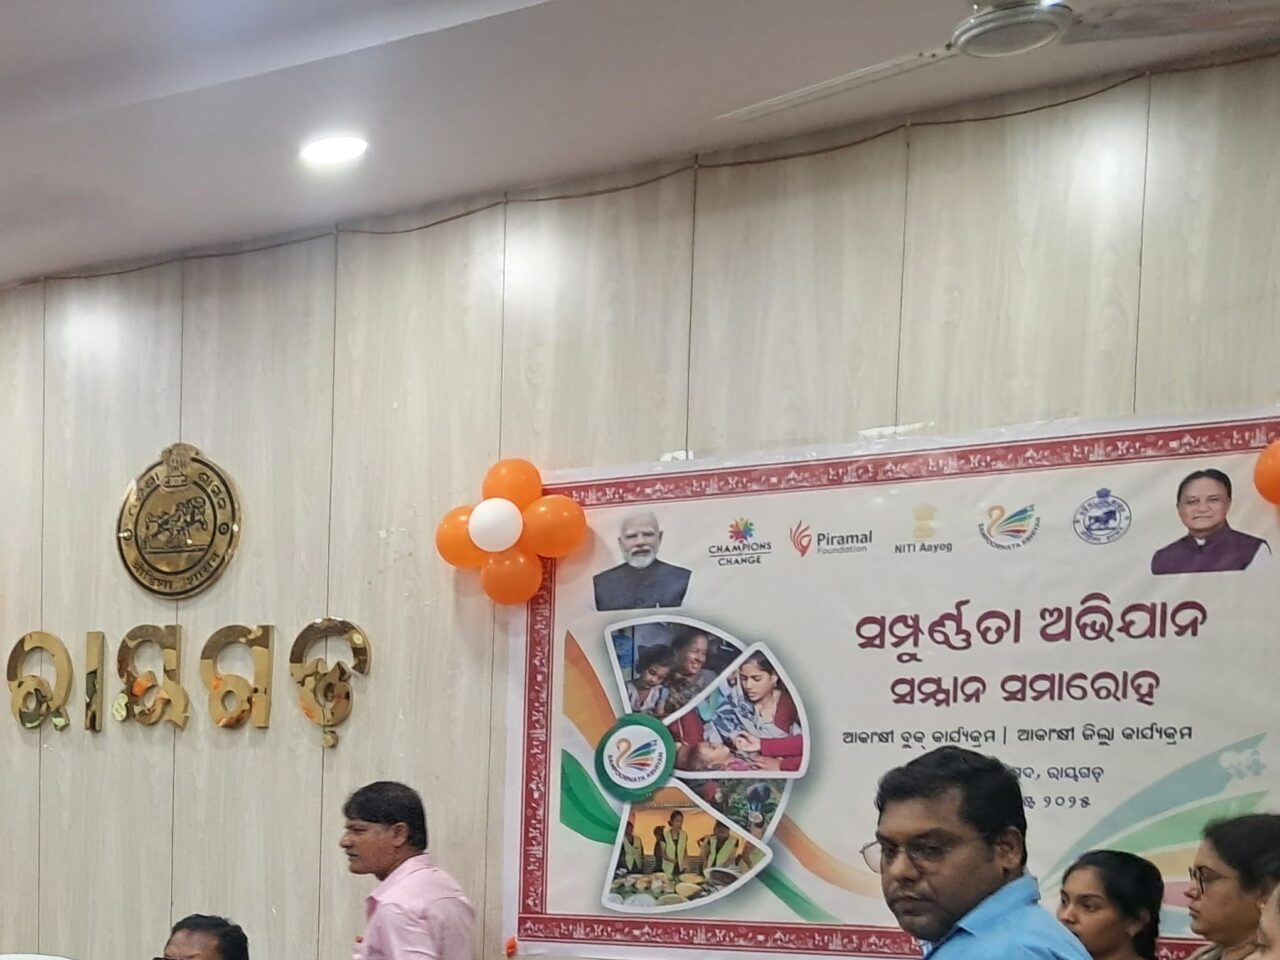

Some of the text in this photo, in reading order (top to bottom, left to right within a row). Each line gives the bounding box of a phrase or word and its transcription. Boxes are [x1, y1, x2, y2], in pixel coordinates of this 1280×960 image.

[817, 530, 873, 547] Piramal
[708, 541, 772, 555] CHAMPIONS
[894, 541, 953, 554] NITI Aayog
[717, 555, 762, 567] CHANGE
[1000, 670, 1160, 706] ସମାରୋହ
[1043, 796, 1091, 809] ୨୦୨୫
